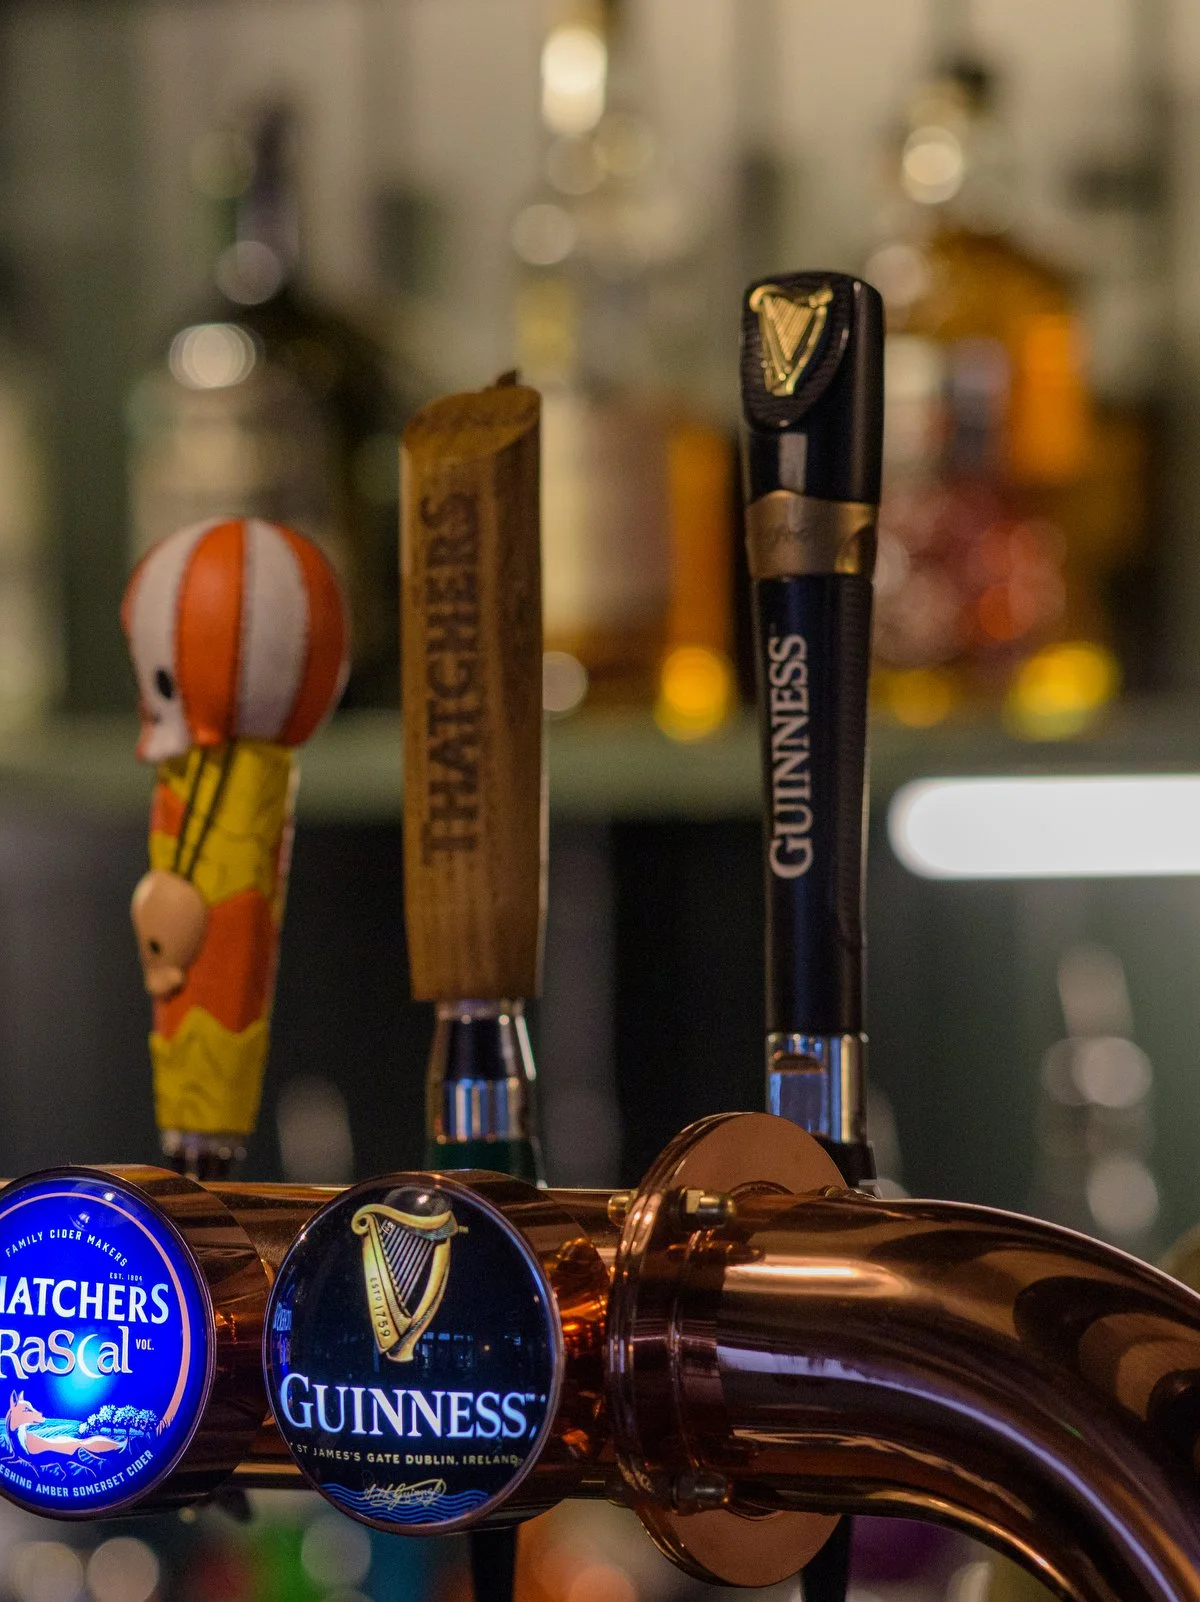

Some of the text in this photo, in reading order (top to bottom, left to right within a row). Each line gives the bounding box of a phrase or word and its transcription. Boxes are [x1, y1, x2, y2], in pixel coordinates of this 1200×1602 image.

[420, 490, 481, 868] THATCHERS
[769, 633, 813, 880] GUINNESS
[5, 1228, 128, 1267] FAMILY CIDER MAKERS
[109, 1271, 124, 1280] EST.
[374, 1305, 391, 1338] 1759
[135, 1338, 155, 1351] VOL.
[280, 1372, 528, 1439] GUINNESS
[35, 1483, 69, 1498] AMBER
[73, 1472, 125, 1498] SOMERSET
[126, 1449, 154, 1477] CIDER
[313, 1447, 361, 1461] JAMES'S
[366, 1452, 400, 1464] GATE
